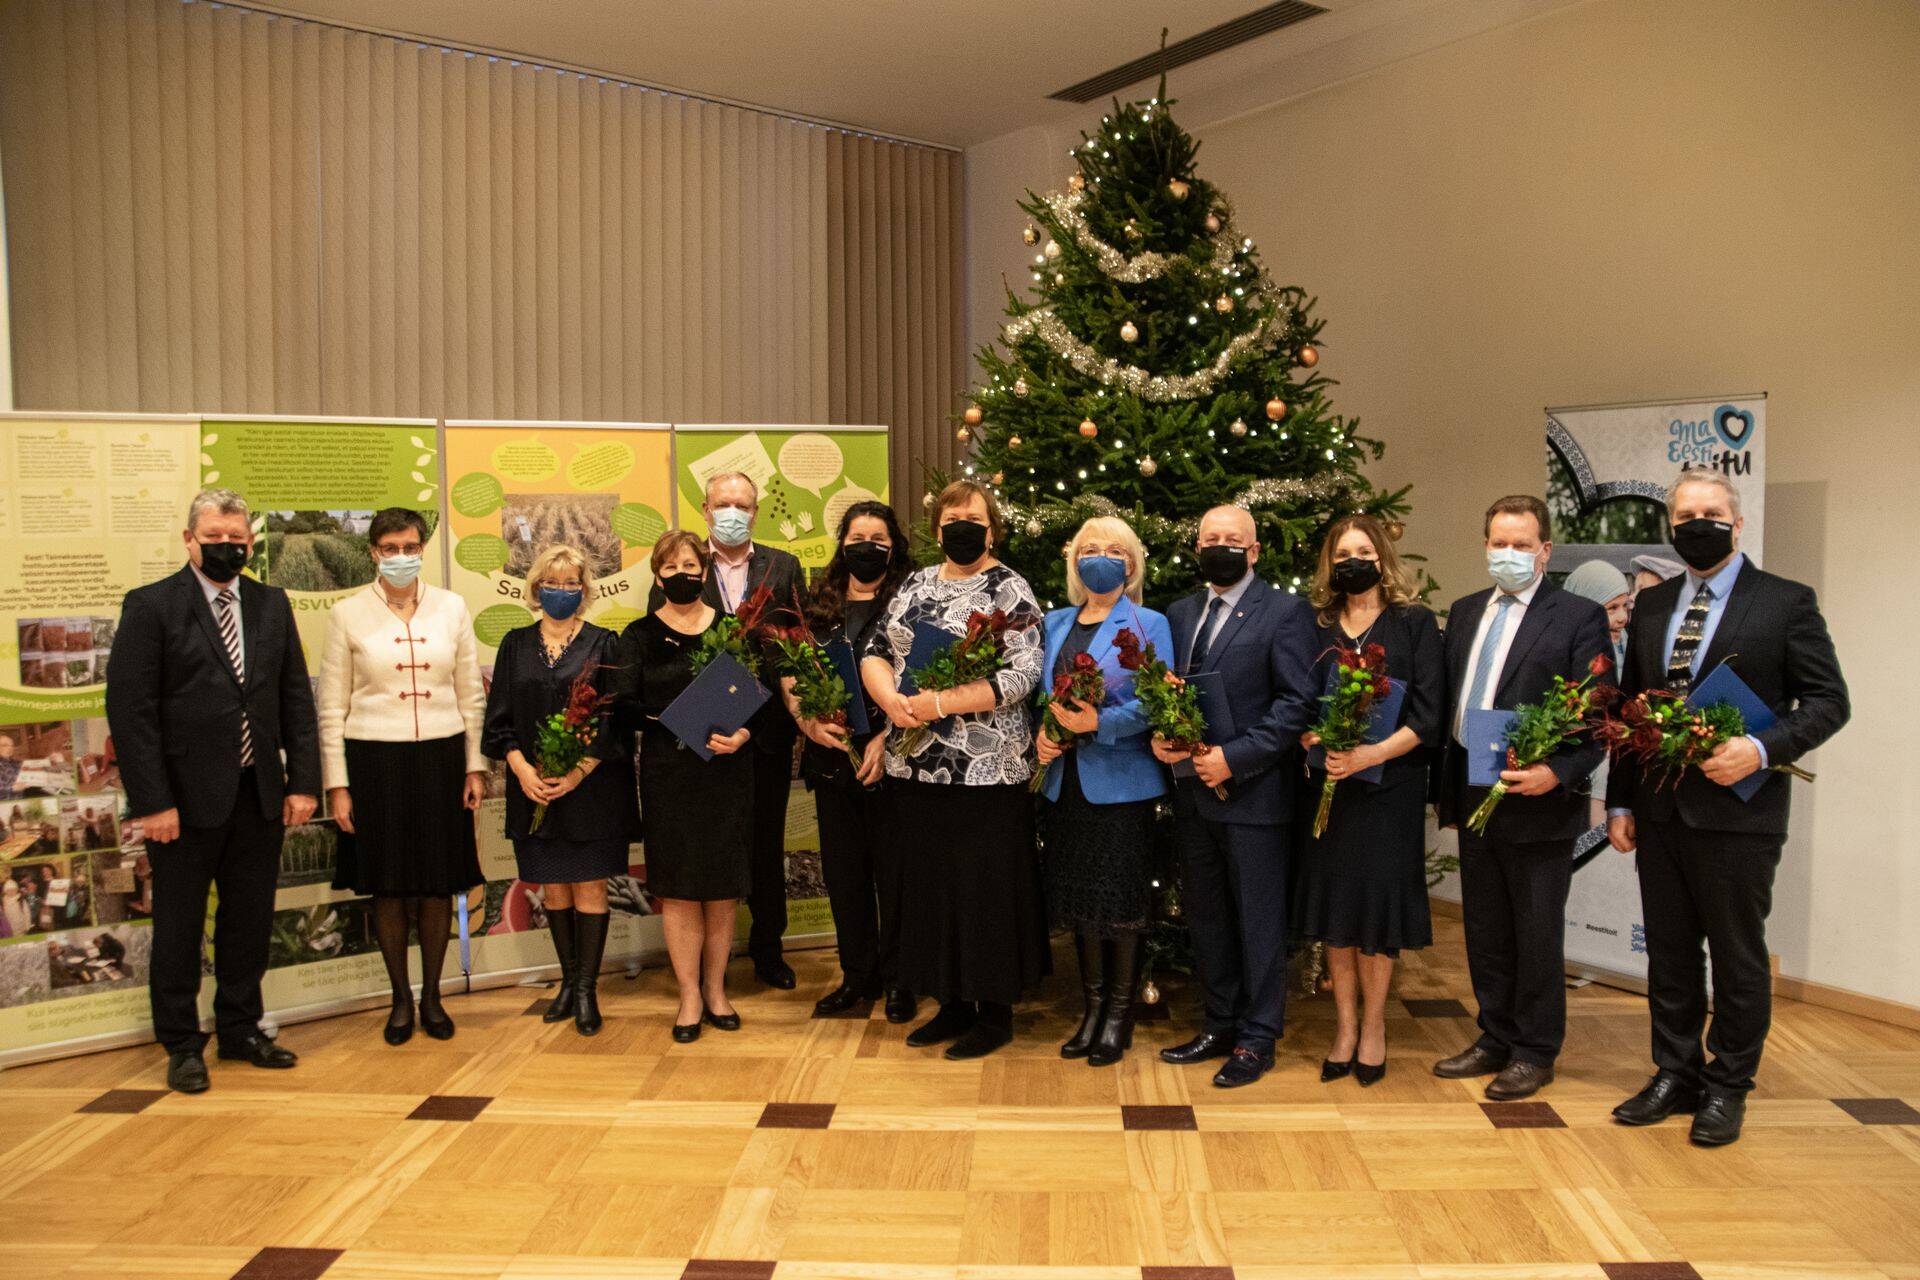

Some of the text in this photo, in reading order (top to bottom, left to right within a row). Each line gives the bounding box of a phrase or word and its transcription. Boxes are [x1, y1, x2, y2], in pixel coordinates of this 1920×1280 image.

[1670, 419, 1718, 446] Ma
[1668, 440, 1713, 463] Eesti
[1681, 450, 1751, 476] itu
[789, 544, 826, 559] aeg
[290, 596, 346, 611] asvu
